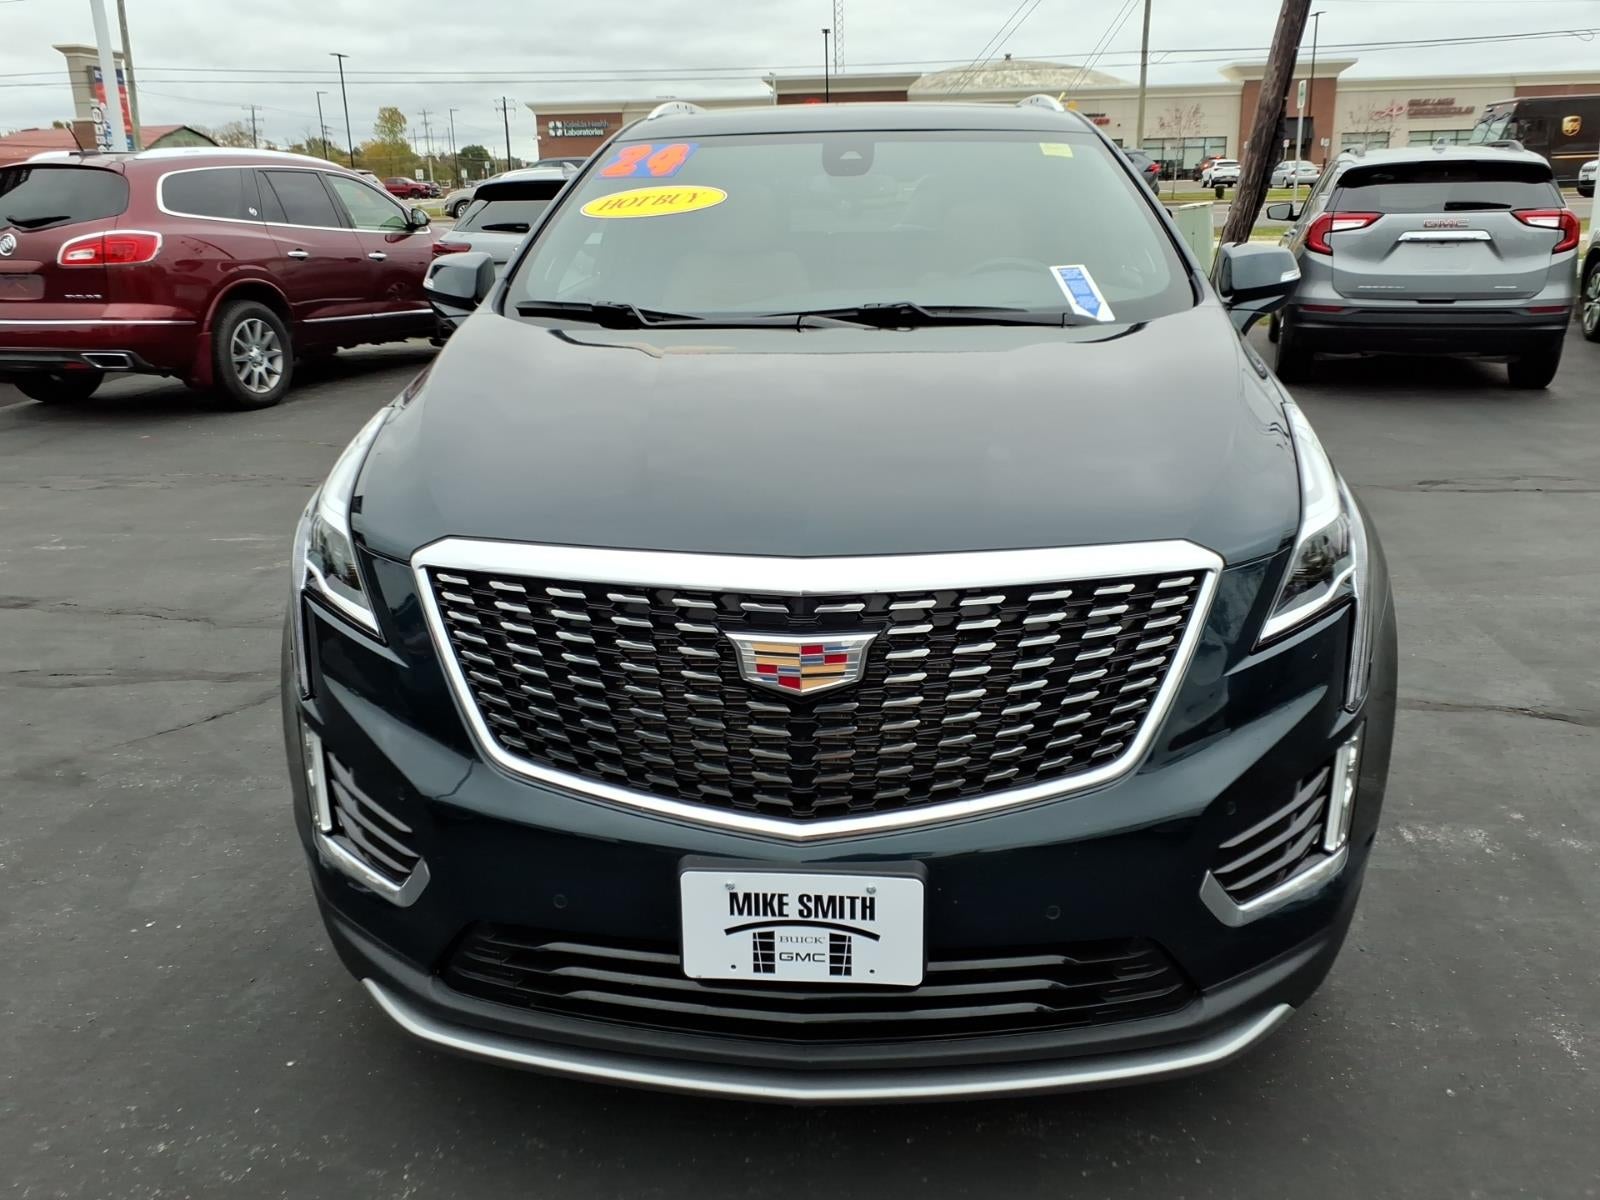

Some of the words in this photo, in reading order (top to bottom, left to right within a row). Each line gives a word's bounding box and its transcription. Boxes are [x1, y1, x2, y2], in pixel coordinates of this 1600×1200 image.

[564, 128, 604, 136] Laboratories
[600, 143, 691, 176] 24
[598, 195, 656, 211] HOT
[652, 192, 706, 206] BUY
[1423, 218, 1469, 229] GMC
[729, 891, 790, 918] MIKE
[798, 893, 876, 921] SMITH
[779, 935, 824, 944] BUICK
[778, 951, 826, 963] GMC
